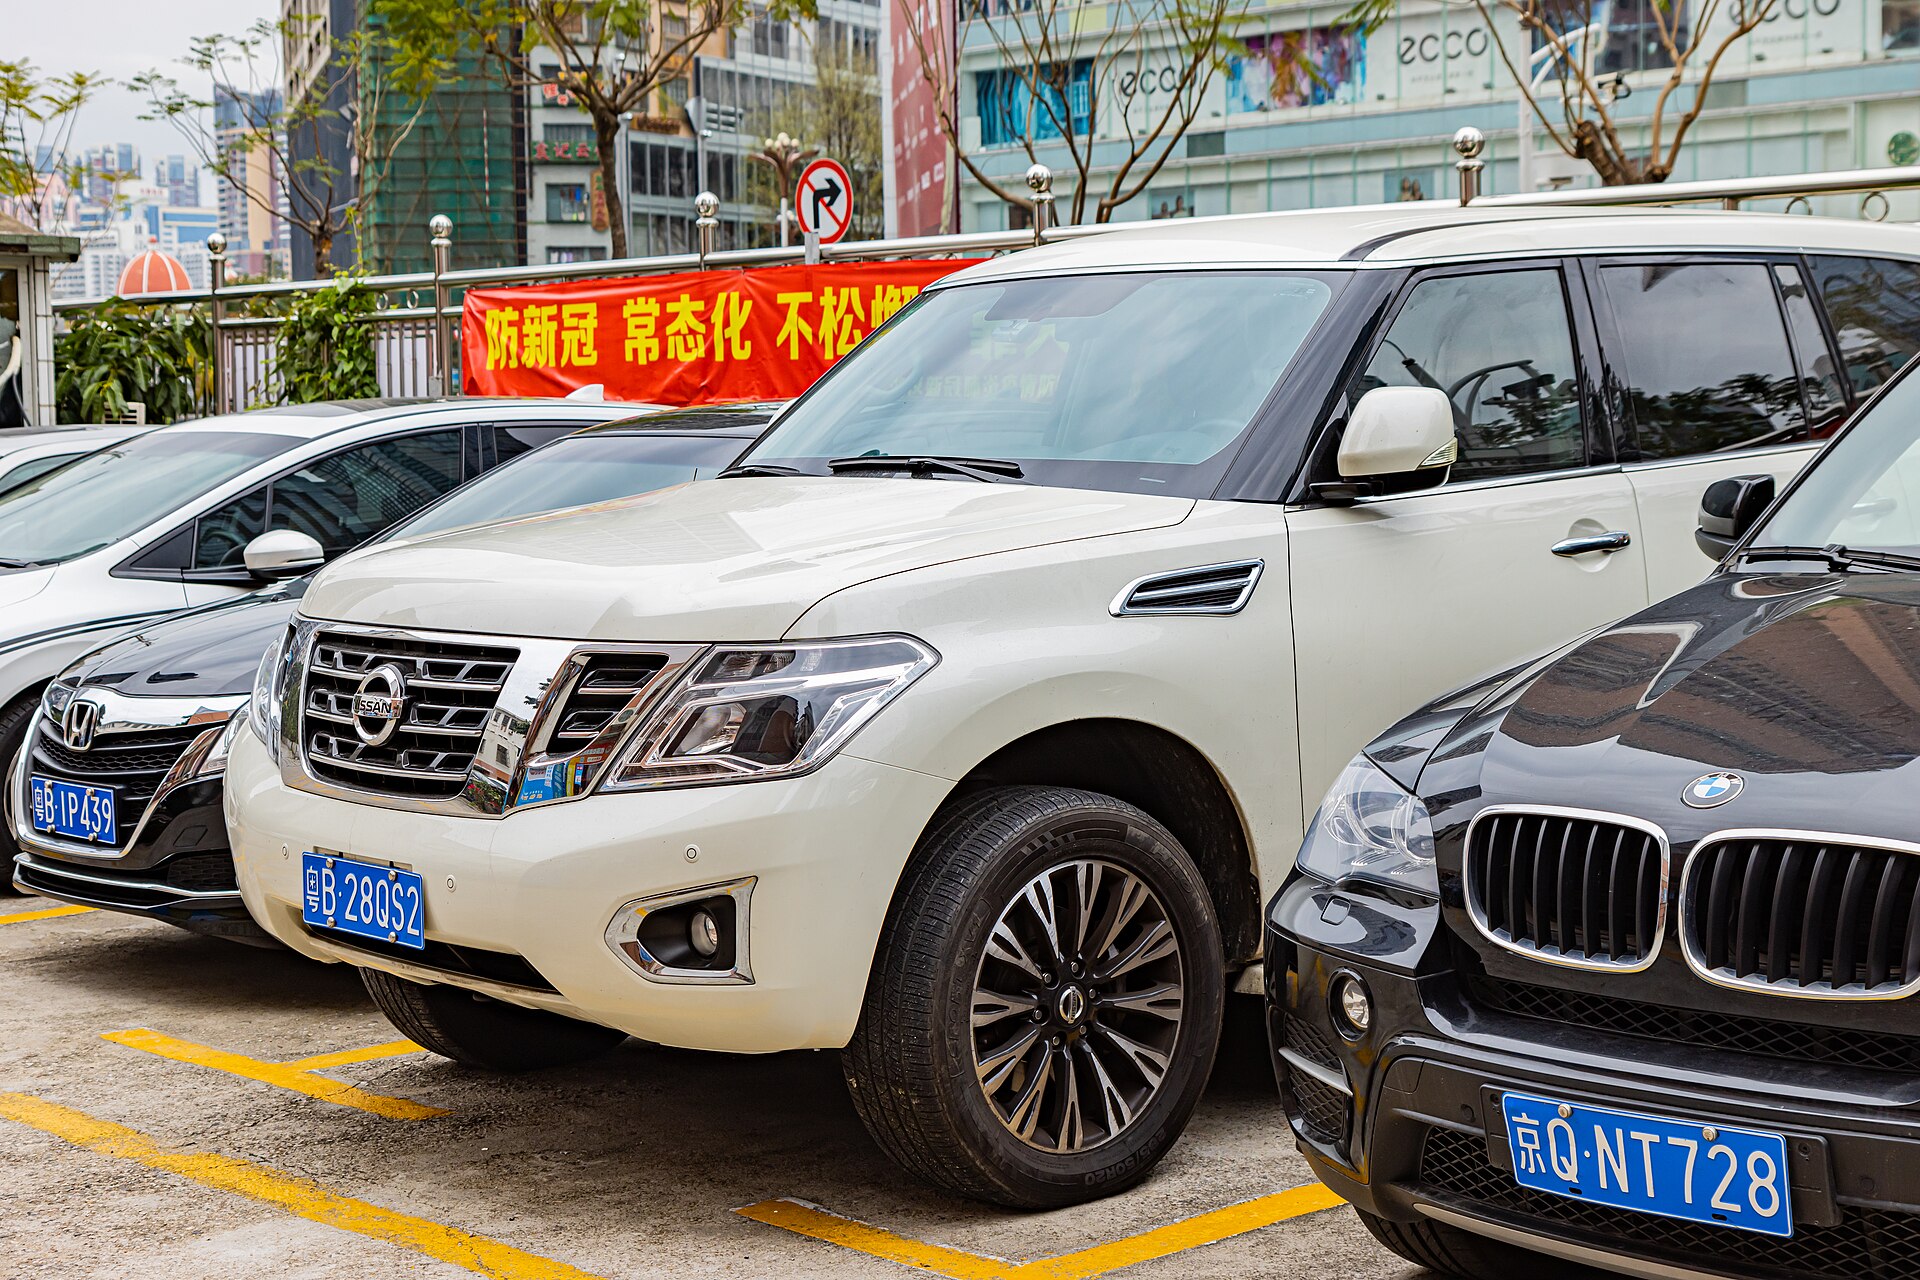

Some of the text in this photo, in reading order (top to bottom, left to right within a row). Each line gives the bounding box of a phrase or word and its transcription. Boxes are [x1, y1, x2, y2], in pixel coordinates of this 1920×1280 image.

[1397, 27, 1489, 65] ecco
[485, 302, 599, 371] 防新冠
[622, 292, 753, 366] 常态化
[1511, 1112, 1780, 1218] 京Q·NT728
